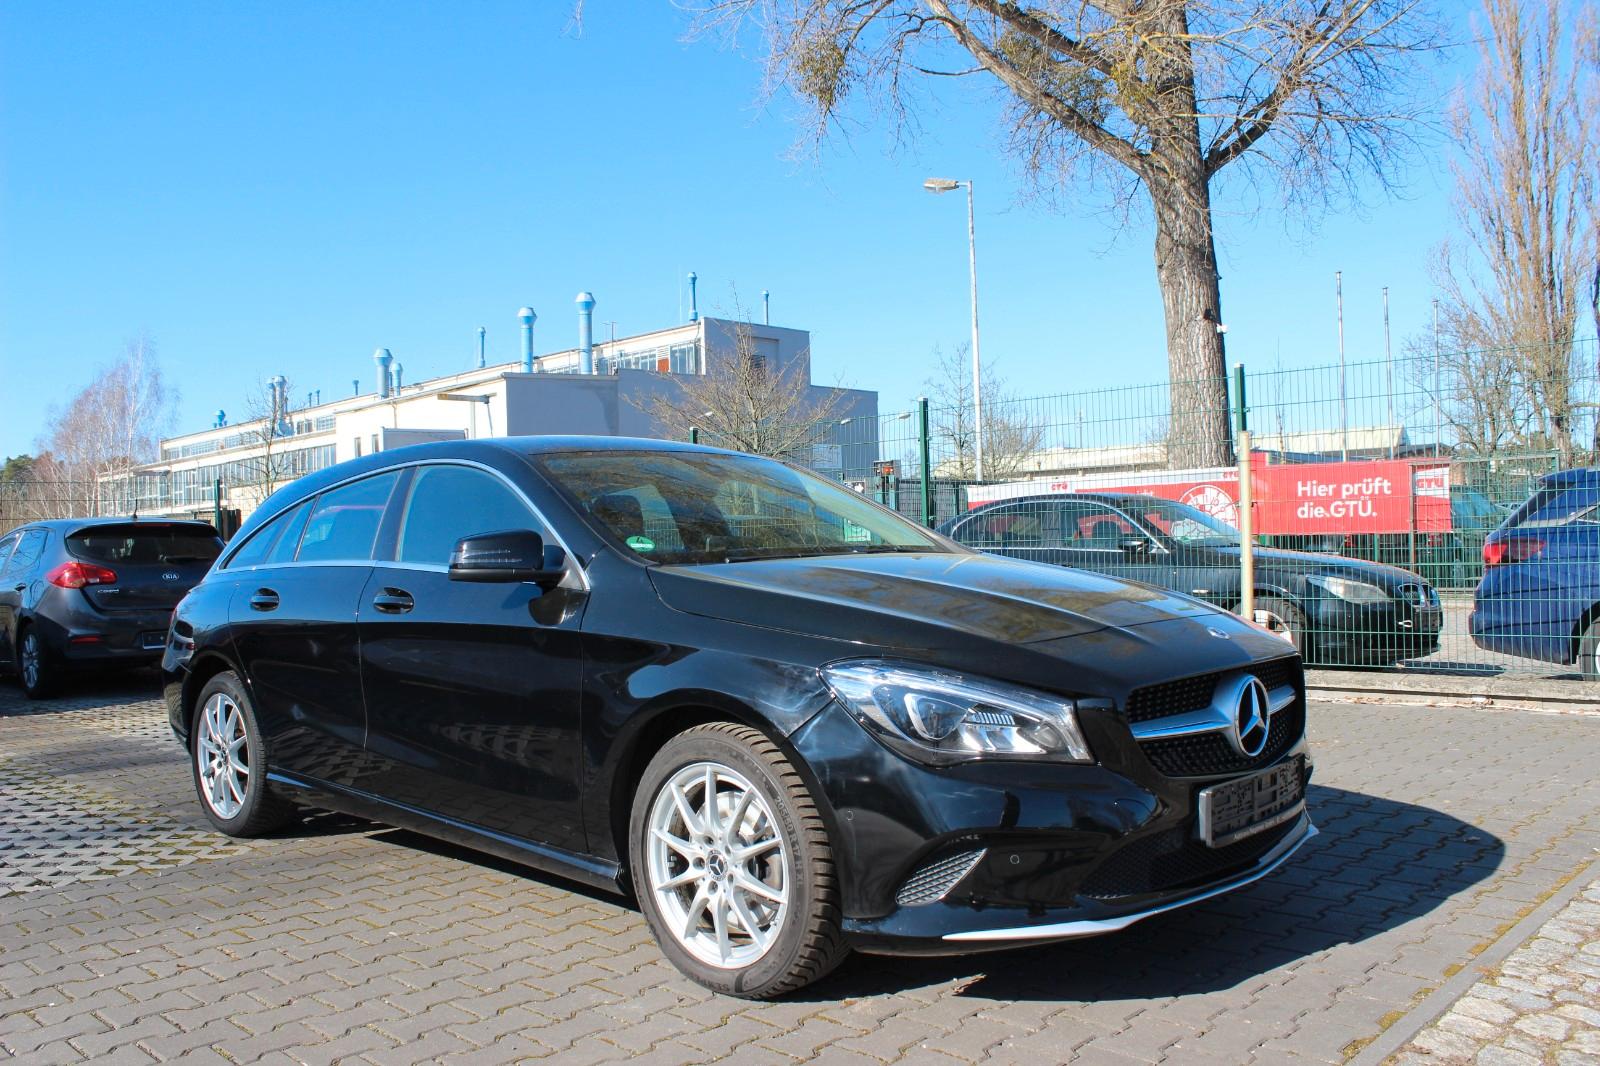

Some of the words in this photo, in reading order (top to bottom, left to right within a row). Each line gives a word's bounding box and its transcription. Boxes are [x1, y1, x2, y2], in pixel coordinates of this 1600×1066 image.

[1297, 480, 1336, 497] Hier
[1342, 477, 1392, 498] prüft
[1330, 496, 1378, 517] GTÜ.
